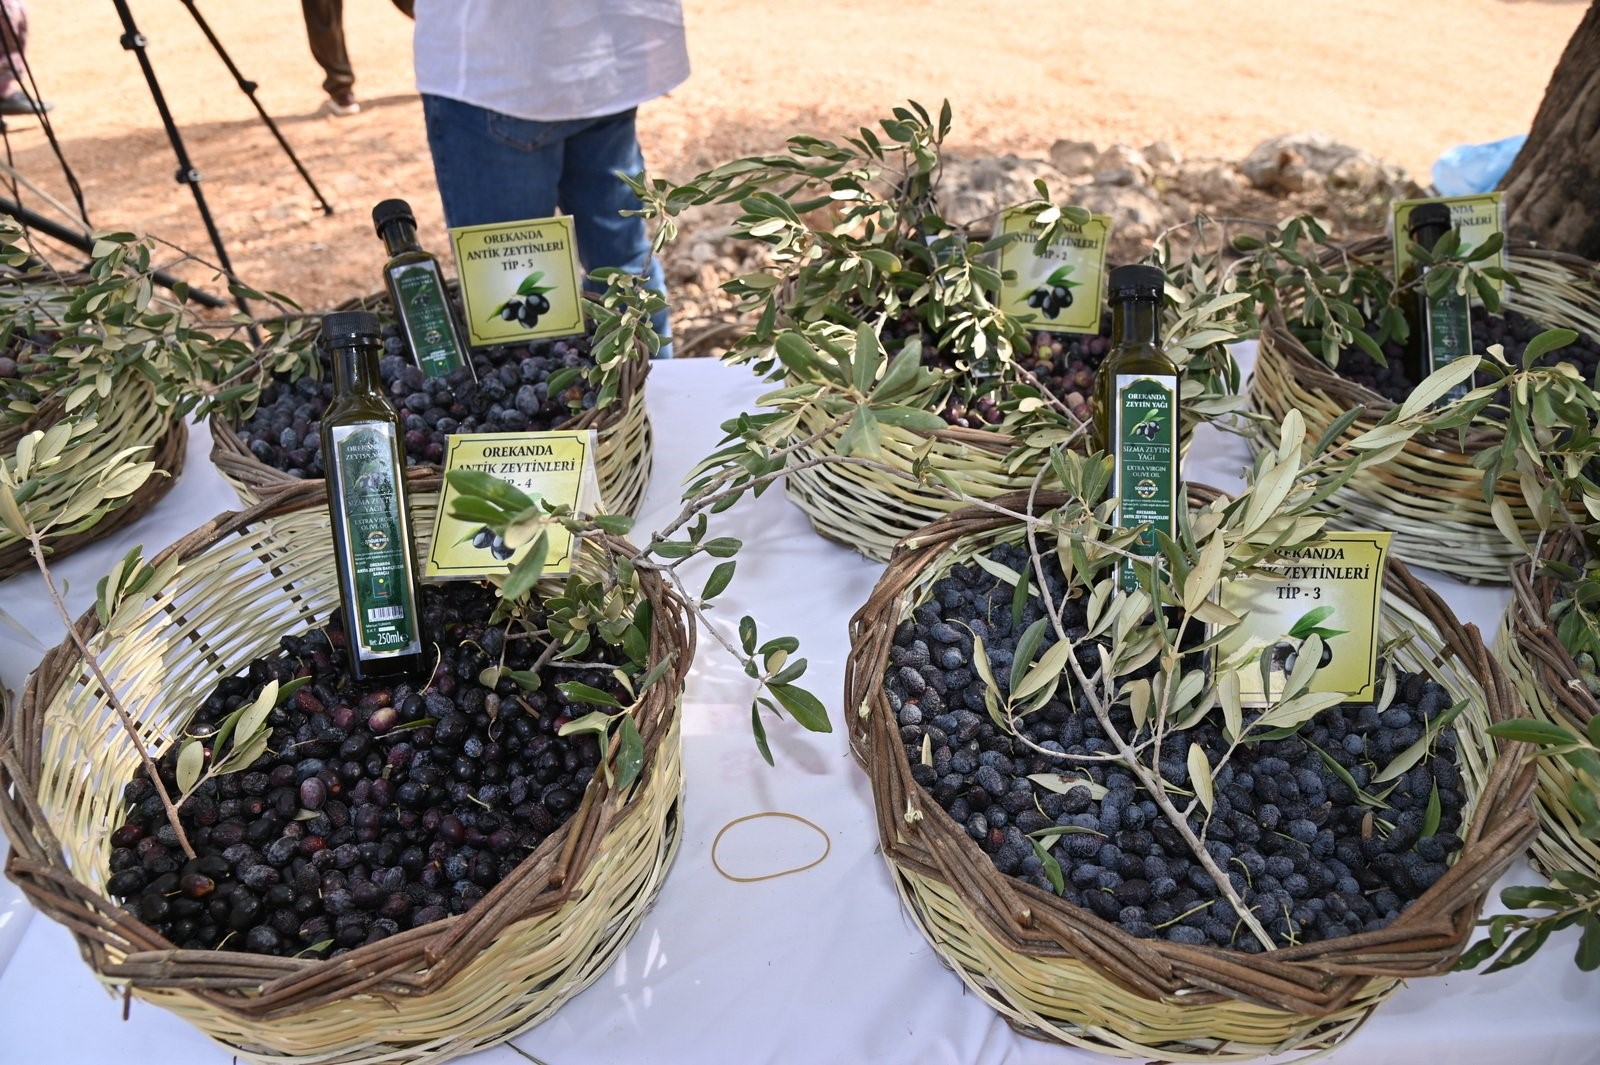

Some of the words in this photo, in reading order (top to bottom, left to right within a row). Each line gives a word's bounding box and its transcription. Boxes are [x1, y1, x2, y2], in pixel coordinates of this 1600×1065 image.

[483, 230, 543, 245] OREKANDA
[466, 246, 500, 261] ANTİK
[503, 239, 565, 257] ZEYTİNLERİ
[1062, 251, 1068, 260] 2
[501, 259, 519, 271] TİP
[528, 259, 534, 268] 5
[1128, 393, 1166, 401] OREKANDA
[482, 445, 553, 458] OREKANDA
[500, 458, 576, 474] ZEYTİNLERİ
[525, 478, 532, 488] 4
[1283, 563, 1370, 579] ZEYTİNLERİ
[1276, 583, 1300, 599] TİP
[1312, 587, 1321, 599] 3
[377, 631, 400, 645] 250ml
